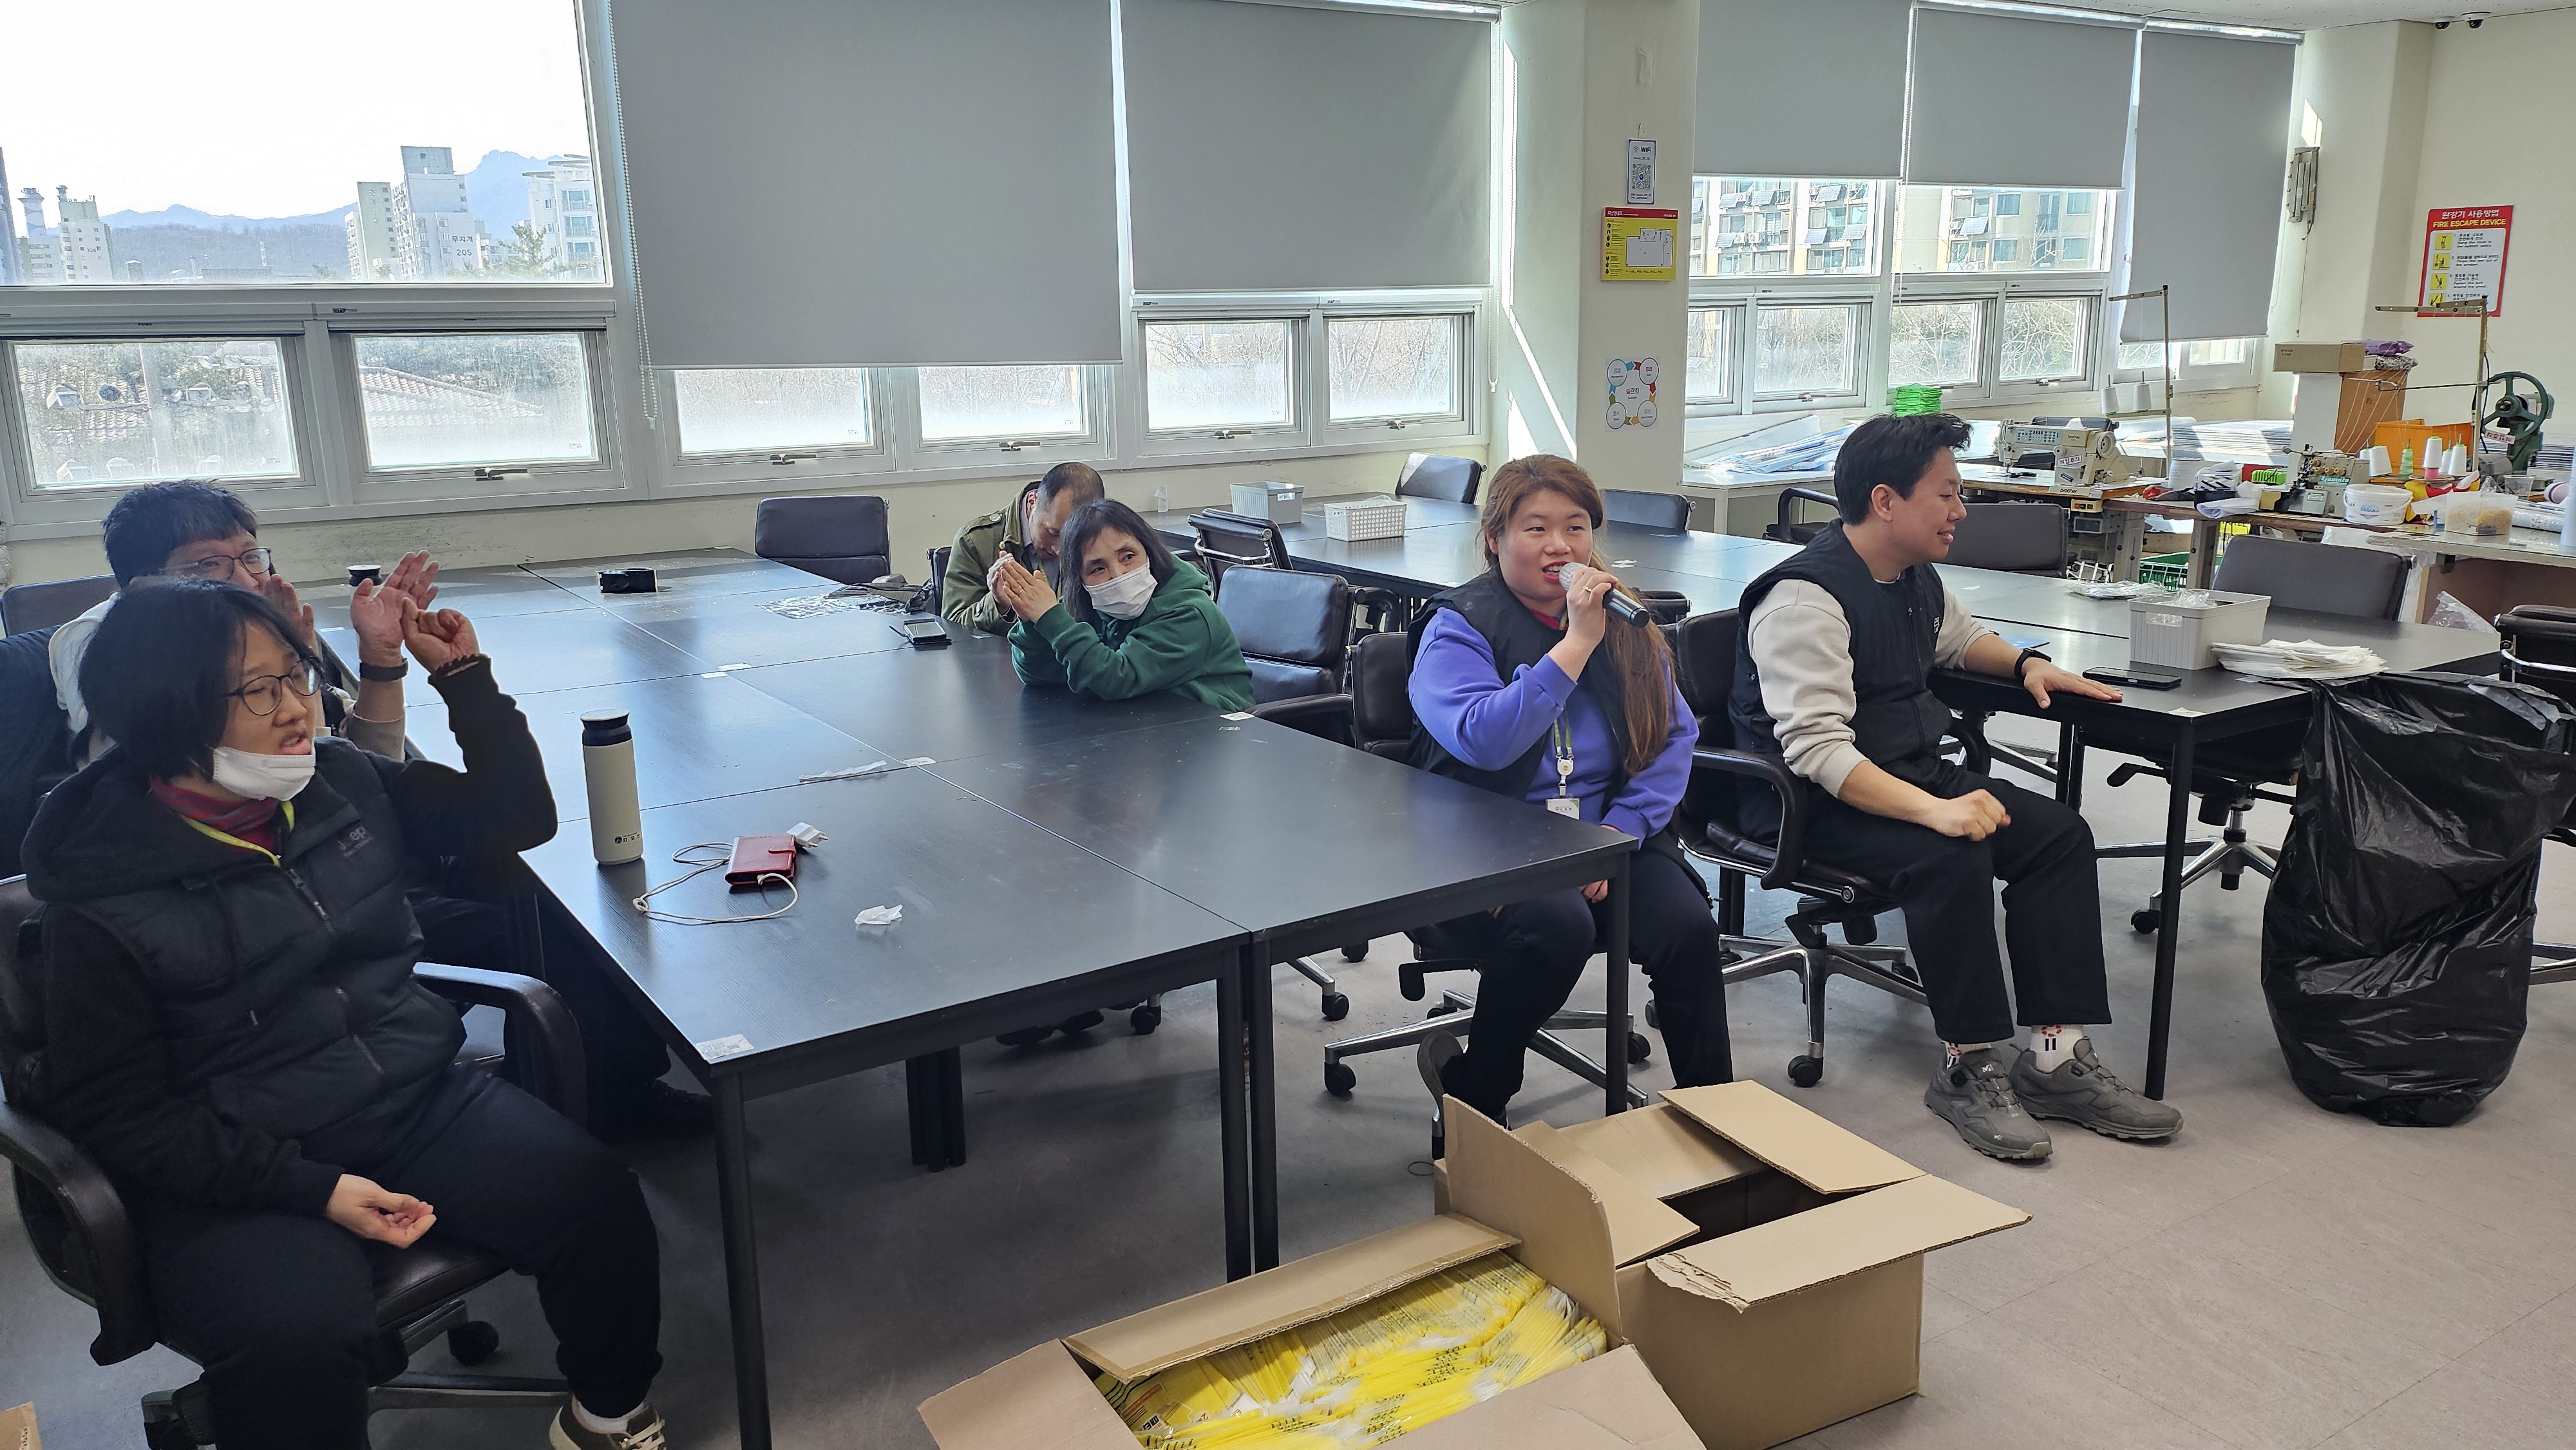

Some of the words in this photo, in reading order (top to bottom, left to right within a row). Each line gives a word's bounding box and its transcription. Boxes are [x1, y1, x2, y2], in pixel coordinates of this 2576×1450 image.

[2441, 210, 2465, 219] 완강기
[2467, 209, 2499, 218] 사용방법
[2450, 219, 2479, 227] ESCAPE
[2059, 456, 2081, 464] 끼임주의
